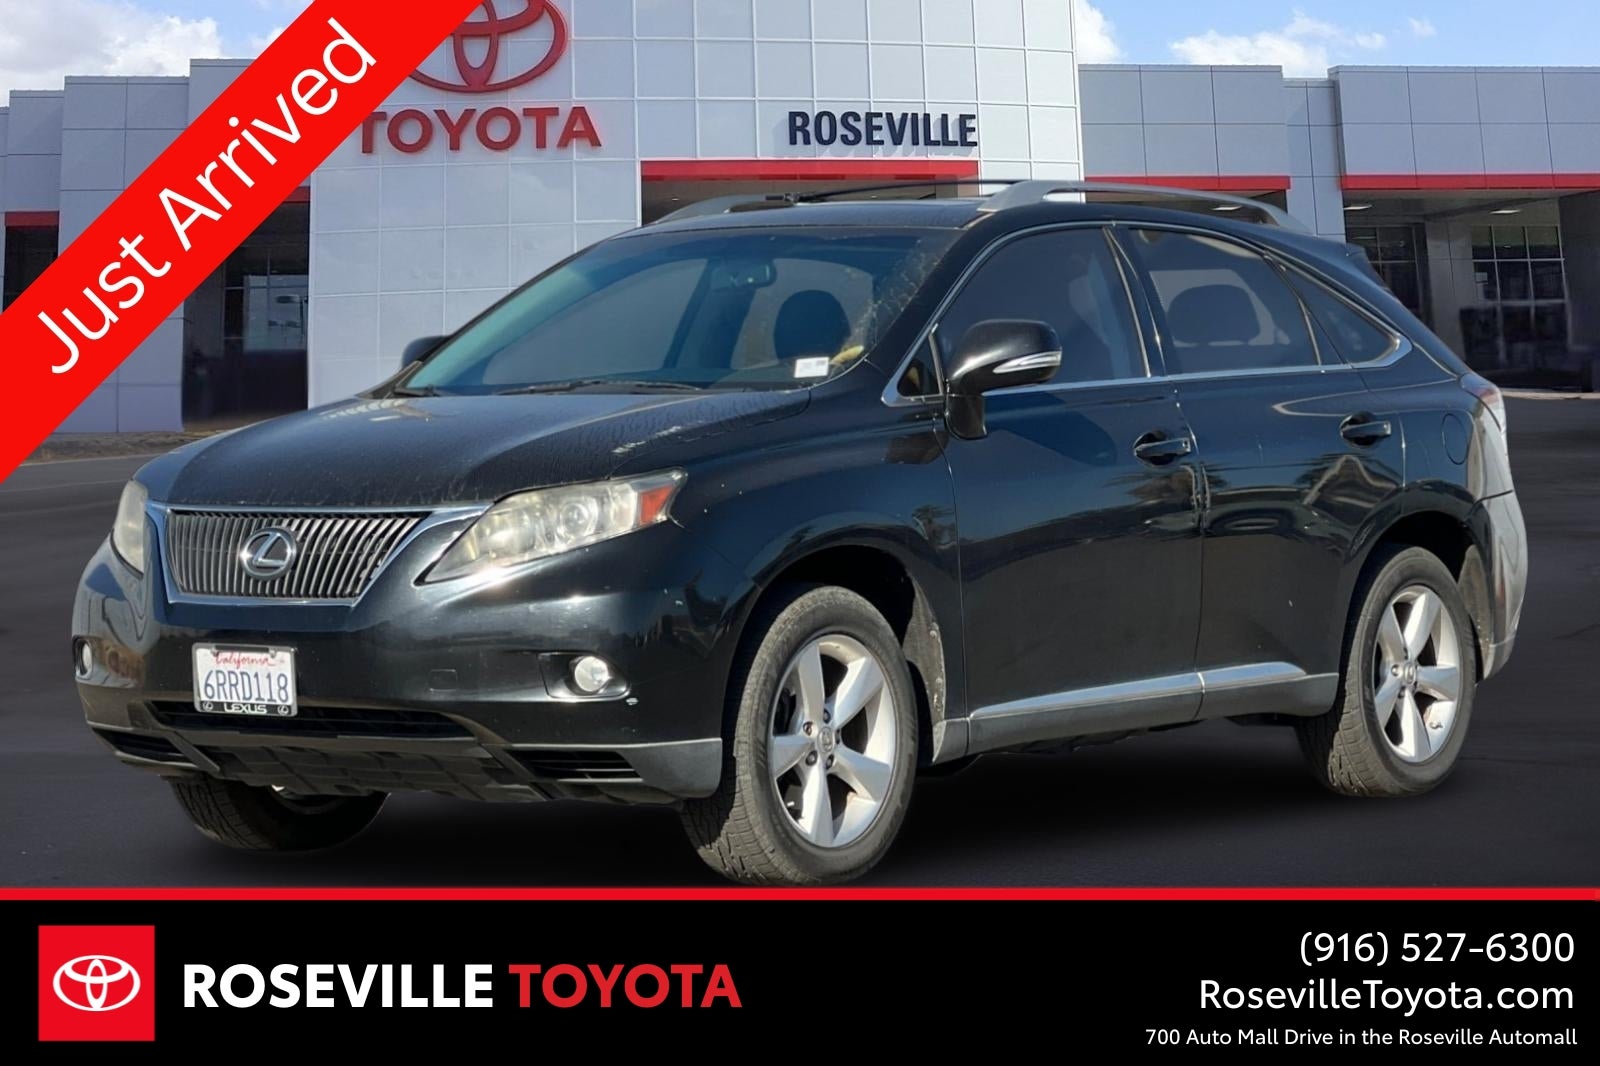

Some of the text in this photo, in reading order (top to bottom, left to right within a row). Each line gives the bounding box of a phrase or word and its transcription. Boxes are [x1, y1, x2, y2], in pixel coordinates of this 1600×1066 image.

[361, 106, 602, 155] TOYOTA
[787, 110, 978, 147] ROSEVILLE
[214, 650, 276, 669] California
[203, 669, 289, 703] 6RRD118
[223, 702, 268, 715] LEXUS
